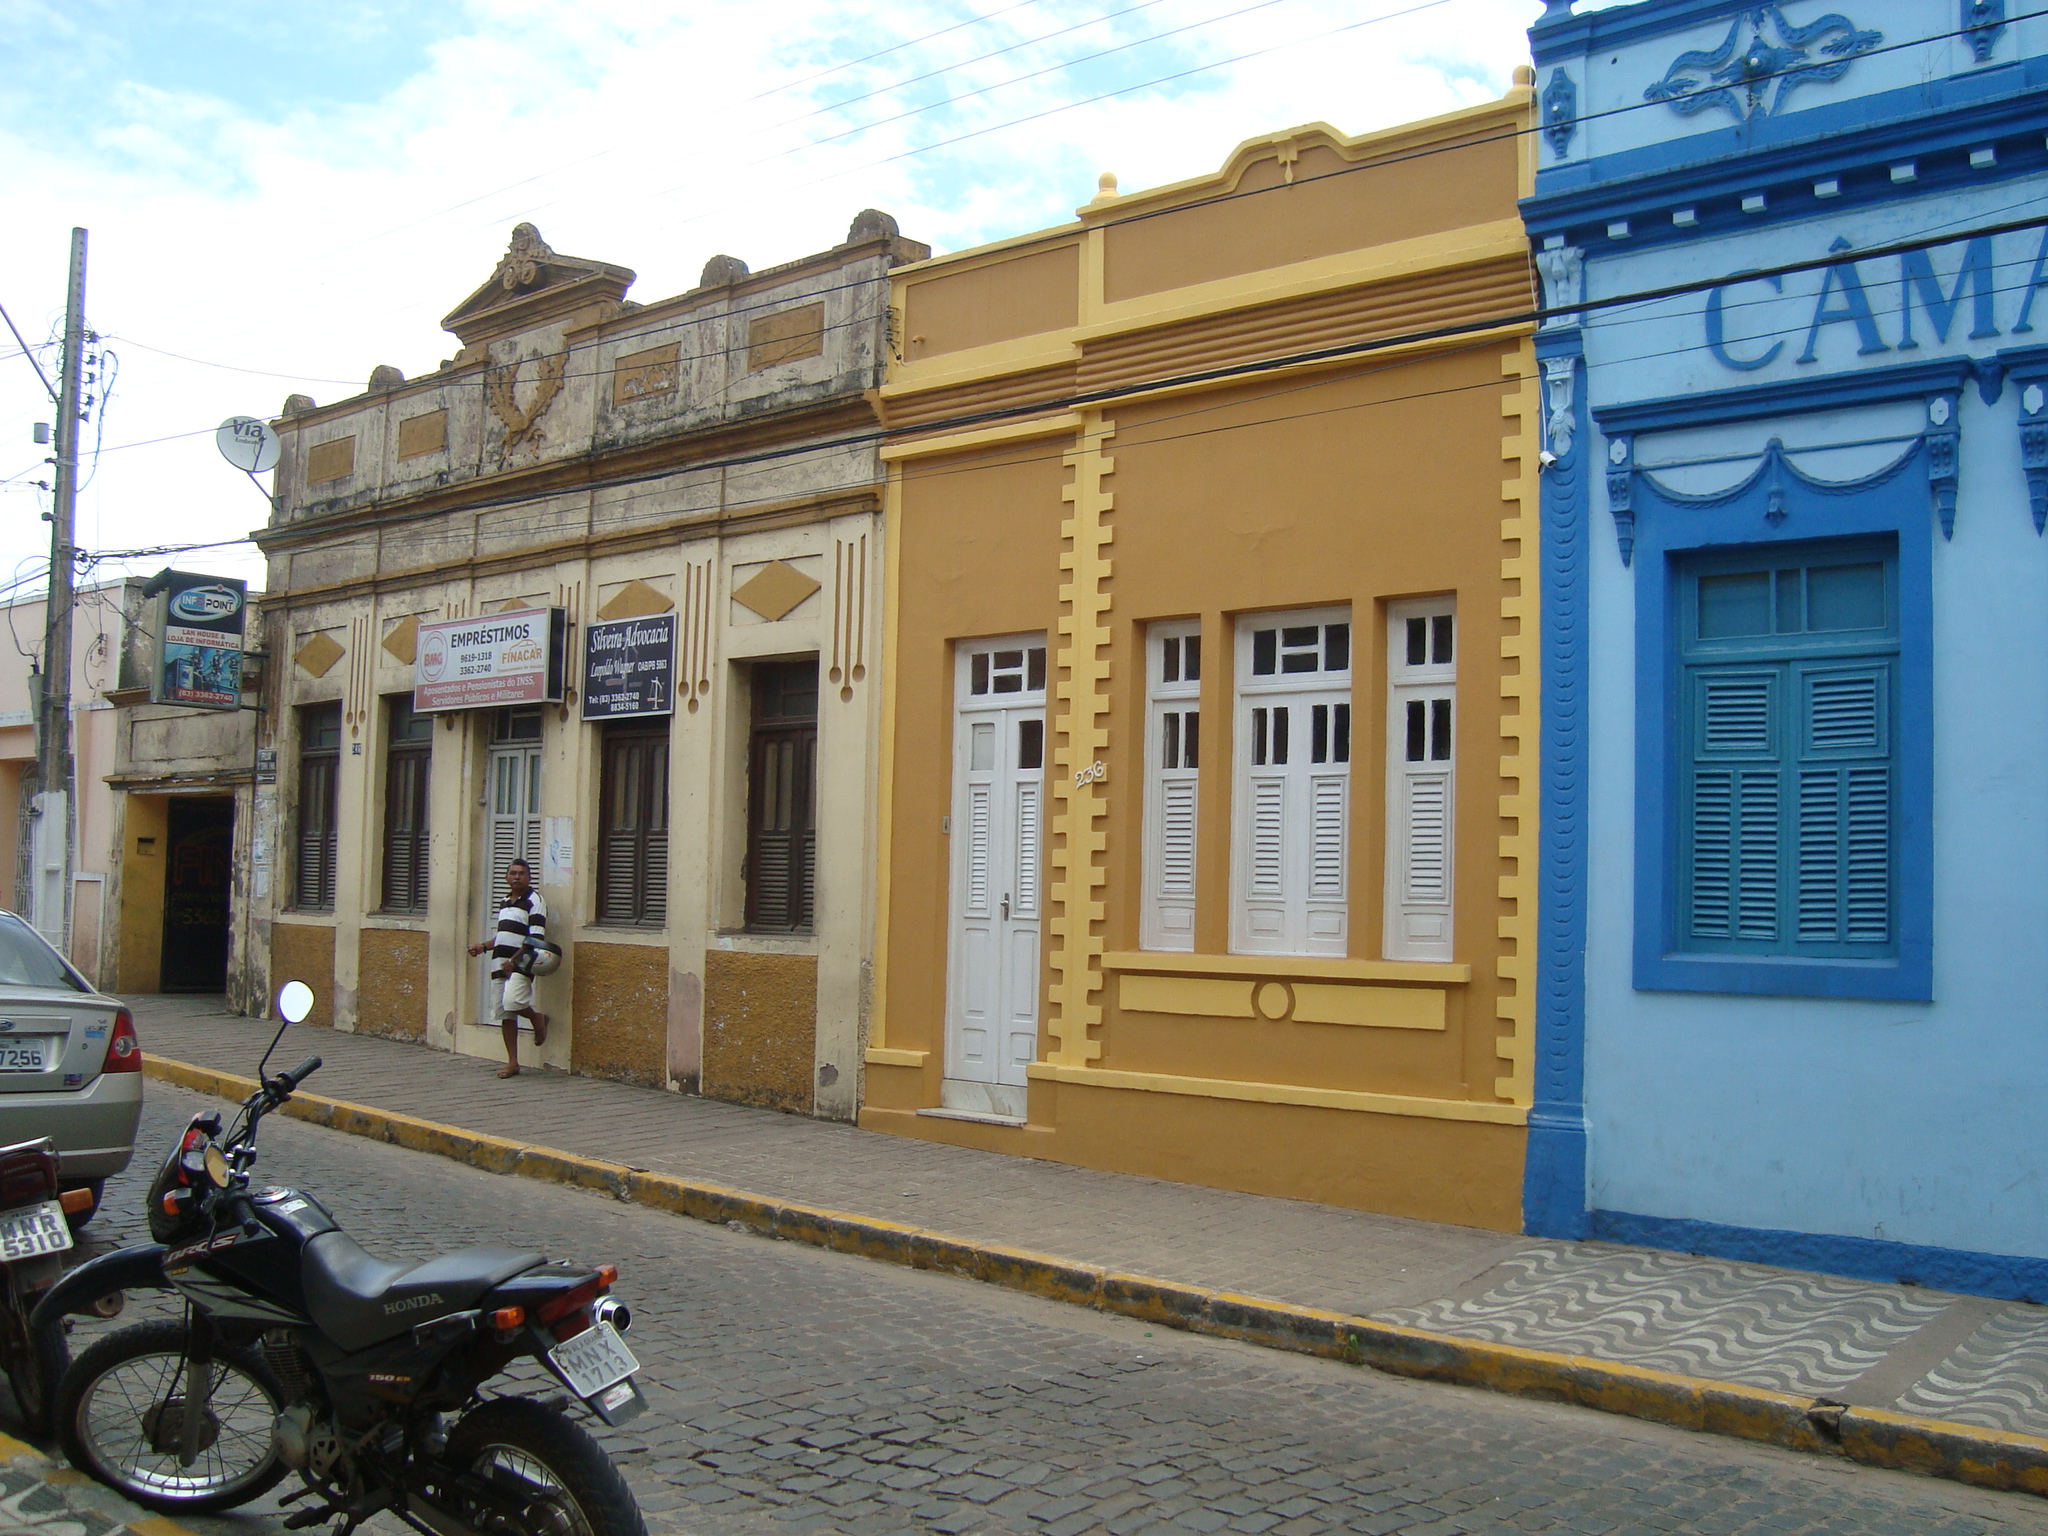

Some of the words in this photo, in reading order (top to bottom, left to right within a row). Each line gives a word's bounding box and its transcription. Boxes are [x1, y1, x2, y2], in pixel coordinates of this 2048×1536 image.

[233, 419, 263, 437] Via
[197, 631, 219, 639] HOUSE
[451, 623, 530, 648] EMPRÉSTIMOS
[591, 626, 622, 653] Silveira
[622, 621, 668, 650] Advocacia
[424, 652, 443, 667] BMG
[460, 651, 492, 663] 9619-1318
[501, 648, 542, 664] FINACAR
[459, 664, 492, 675] 3362-2740
[590, 658, 613, 682] Leopoldo
[614, 656, 635, 679] Wagner
[424, 684, 461, 697] Aposentados
[467, 677, 506, 691] Pensionistas
[507, 678, 515, 687] do
[432, 695, 464, 706] Servidores
[464, 690, 491, 703] Públicos
[496, 690, 525, 701] Militares
[0, 1214, 57, 1240] MNR
[4, 1231, 65, 1257] 5310
[383, 1293, 444, 1315] HONDA
[567, 1339, 617, 1374] MNX
[581, 1355, 628, 1388] 1713
